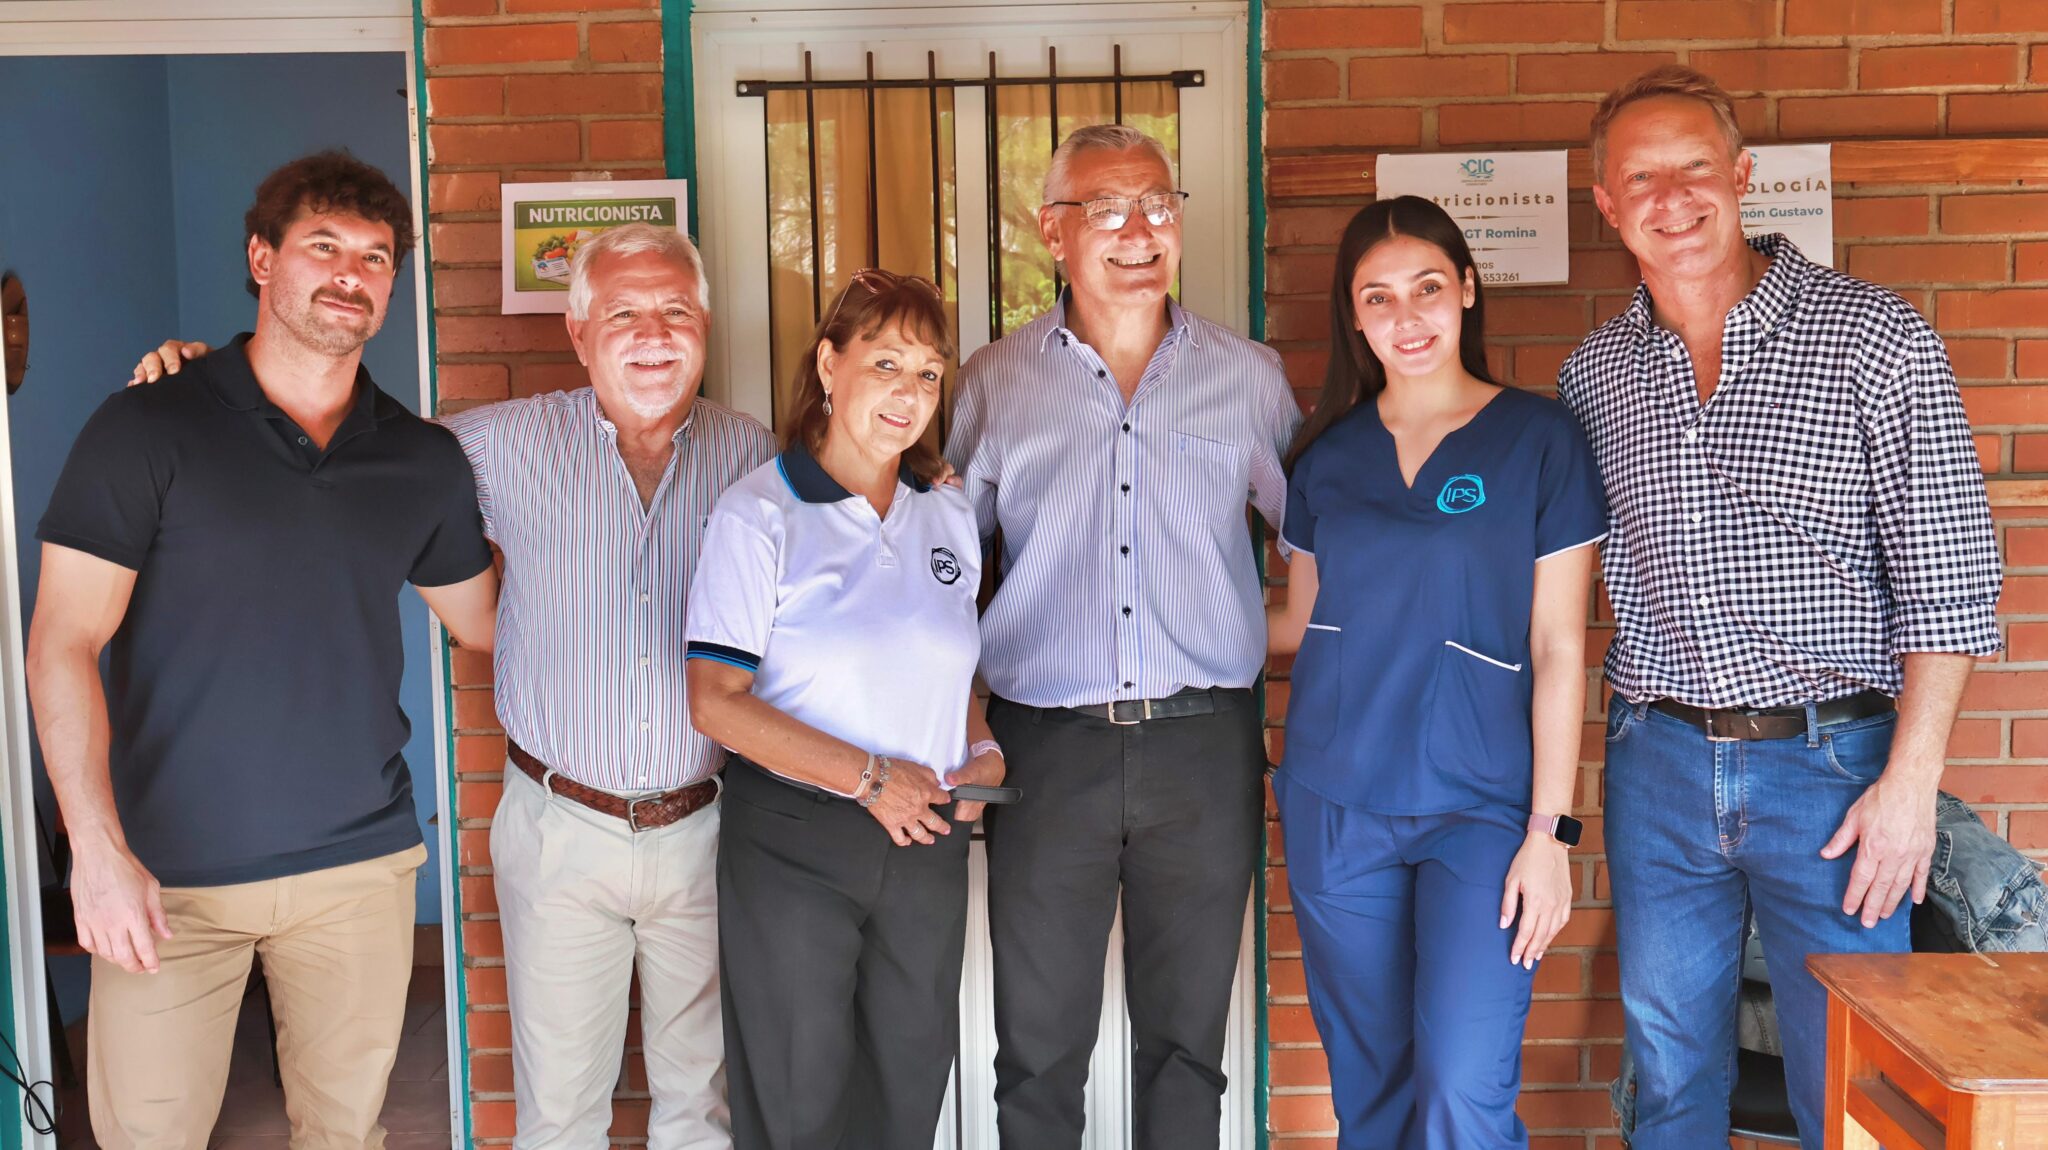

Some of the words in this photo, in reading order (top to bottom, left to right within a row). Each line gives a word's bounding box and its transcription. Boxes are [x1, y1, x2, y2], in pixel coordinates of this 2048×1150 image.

[1467, 158, 1495, 174] CIC
[1746, 177, 1827, 194] OLOGÍA
[1433, 193, 1555, 207] tricionista
[529, 205, 663, 223] NUTRICIONISTA
[1740, 207, 1765, 219] món
[1769, 206, 1824, 218] Gustavo
[1464, 228, 1482, 239] GT
[1485, 226, 1537, 239] Romina
[1476, 262, 1494, 270] nos
[1483, 272, 1520, 283] 553261
[1446, 487, 1477, 503] IPS
[933, 558, 955, 575] IPS
